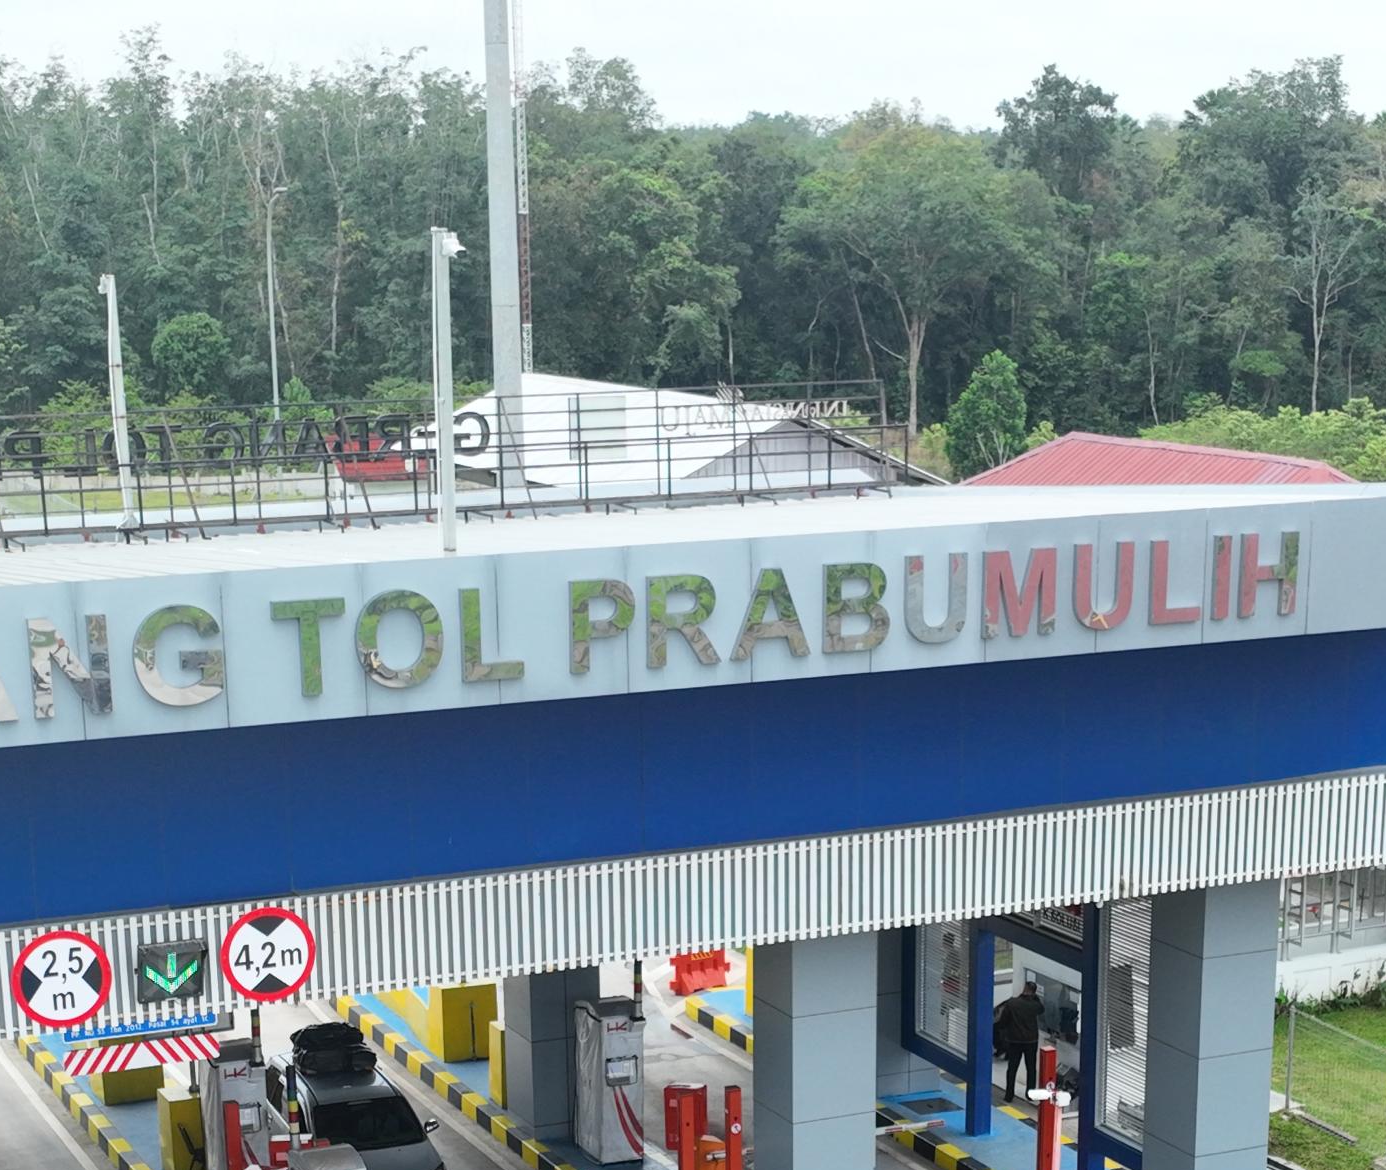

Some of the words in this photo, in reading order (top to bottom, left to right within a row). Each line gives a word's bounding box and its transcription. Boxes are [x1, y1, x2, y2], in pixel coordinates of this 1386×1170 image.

[270, 587, 525, 698] TOL
[568, 531, 1300, 675] PRABUMULIH
[42, 947, 84, 986] 2,5
[53, 992, 76, 1012] m
